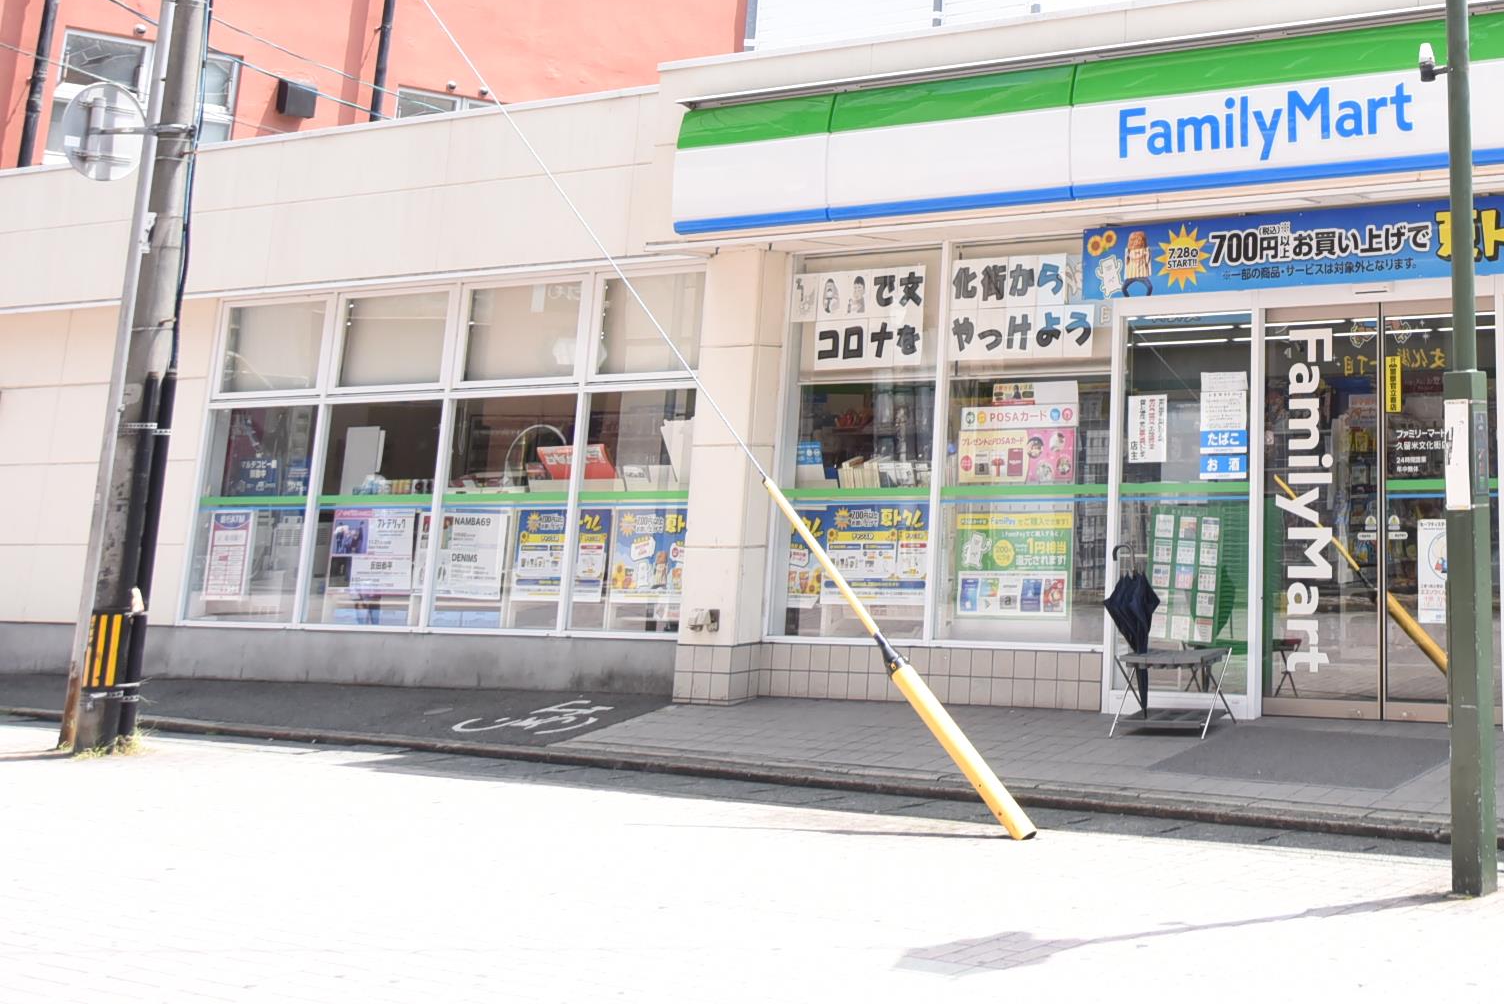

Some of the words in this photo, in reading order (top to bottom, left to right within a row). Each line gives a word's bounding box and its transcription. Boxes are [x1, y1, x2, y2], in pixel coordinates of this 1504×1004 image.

[1117, 81, 1414, 161] FamilyMart
[989, 410, 1047, 423] POSAカード
[1207, 432, 1240, 446] たばこ
[1206, 457, 1240, 471] お酒
[1287, 327, 1333, 673] FamilyMart
[454, 516, 491, 527] NAMBA69
[880, 507, 925, 528] 夏トク！
[451, 552, 478, 563] DENIMS
